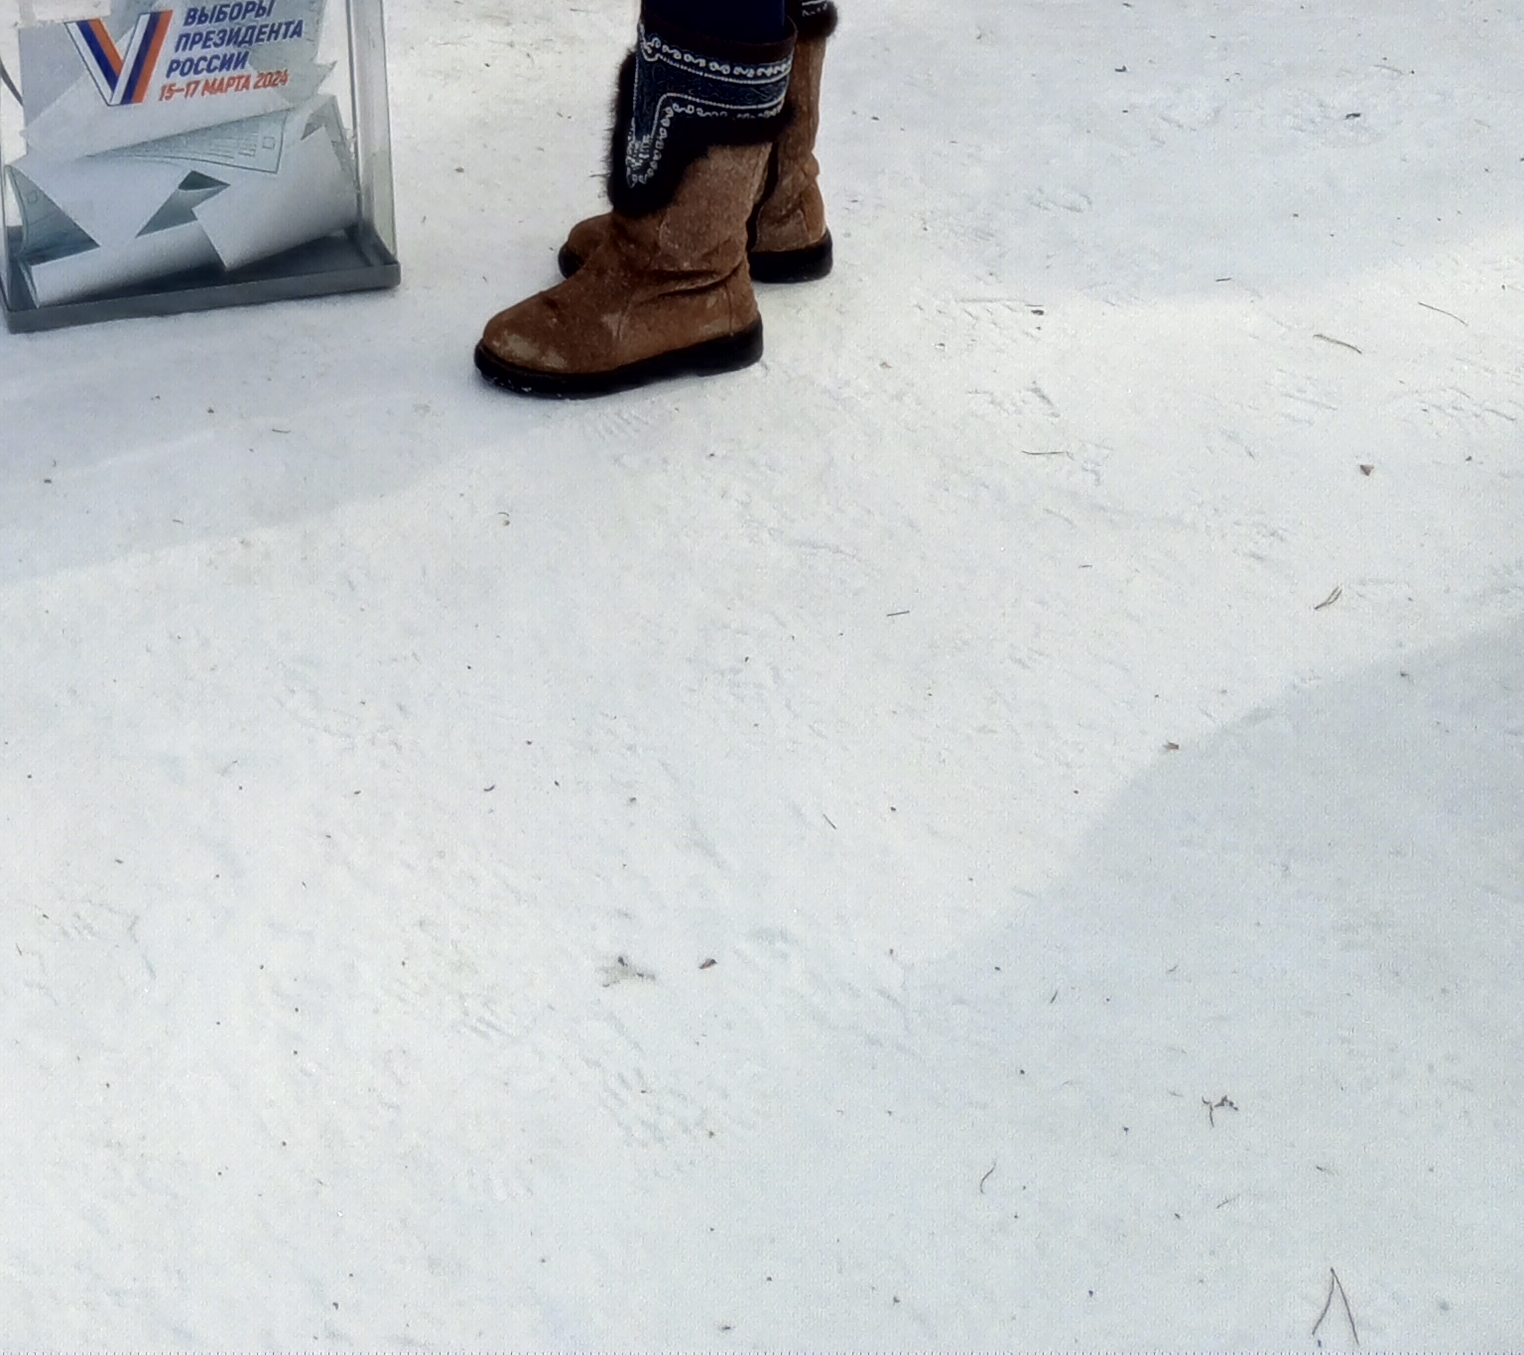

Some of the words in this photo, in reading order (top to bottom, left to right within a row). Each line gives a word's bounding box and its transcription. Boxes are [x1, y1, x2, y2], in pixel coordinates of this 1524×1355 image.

[174, 19, 303, 53] ПРЕЗИДЕНТА
[165, 51, 249, 79] РОССИИ
[201, 74, 252, 97] МАРТА
[253, 69, 290, 90] 2024
